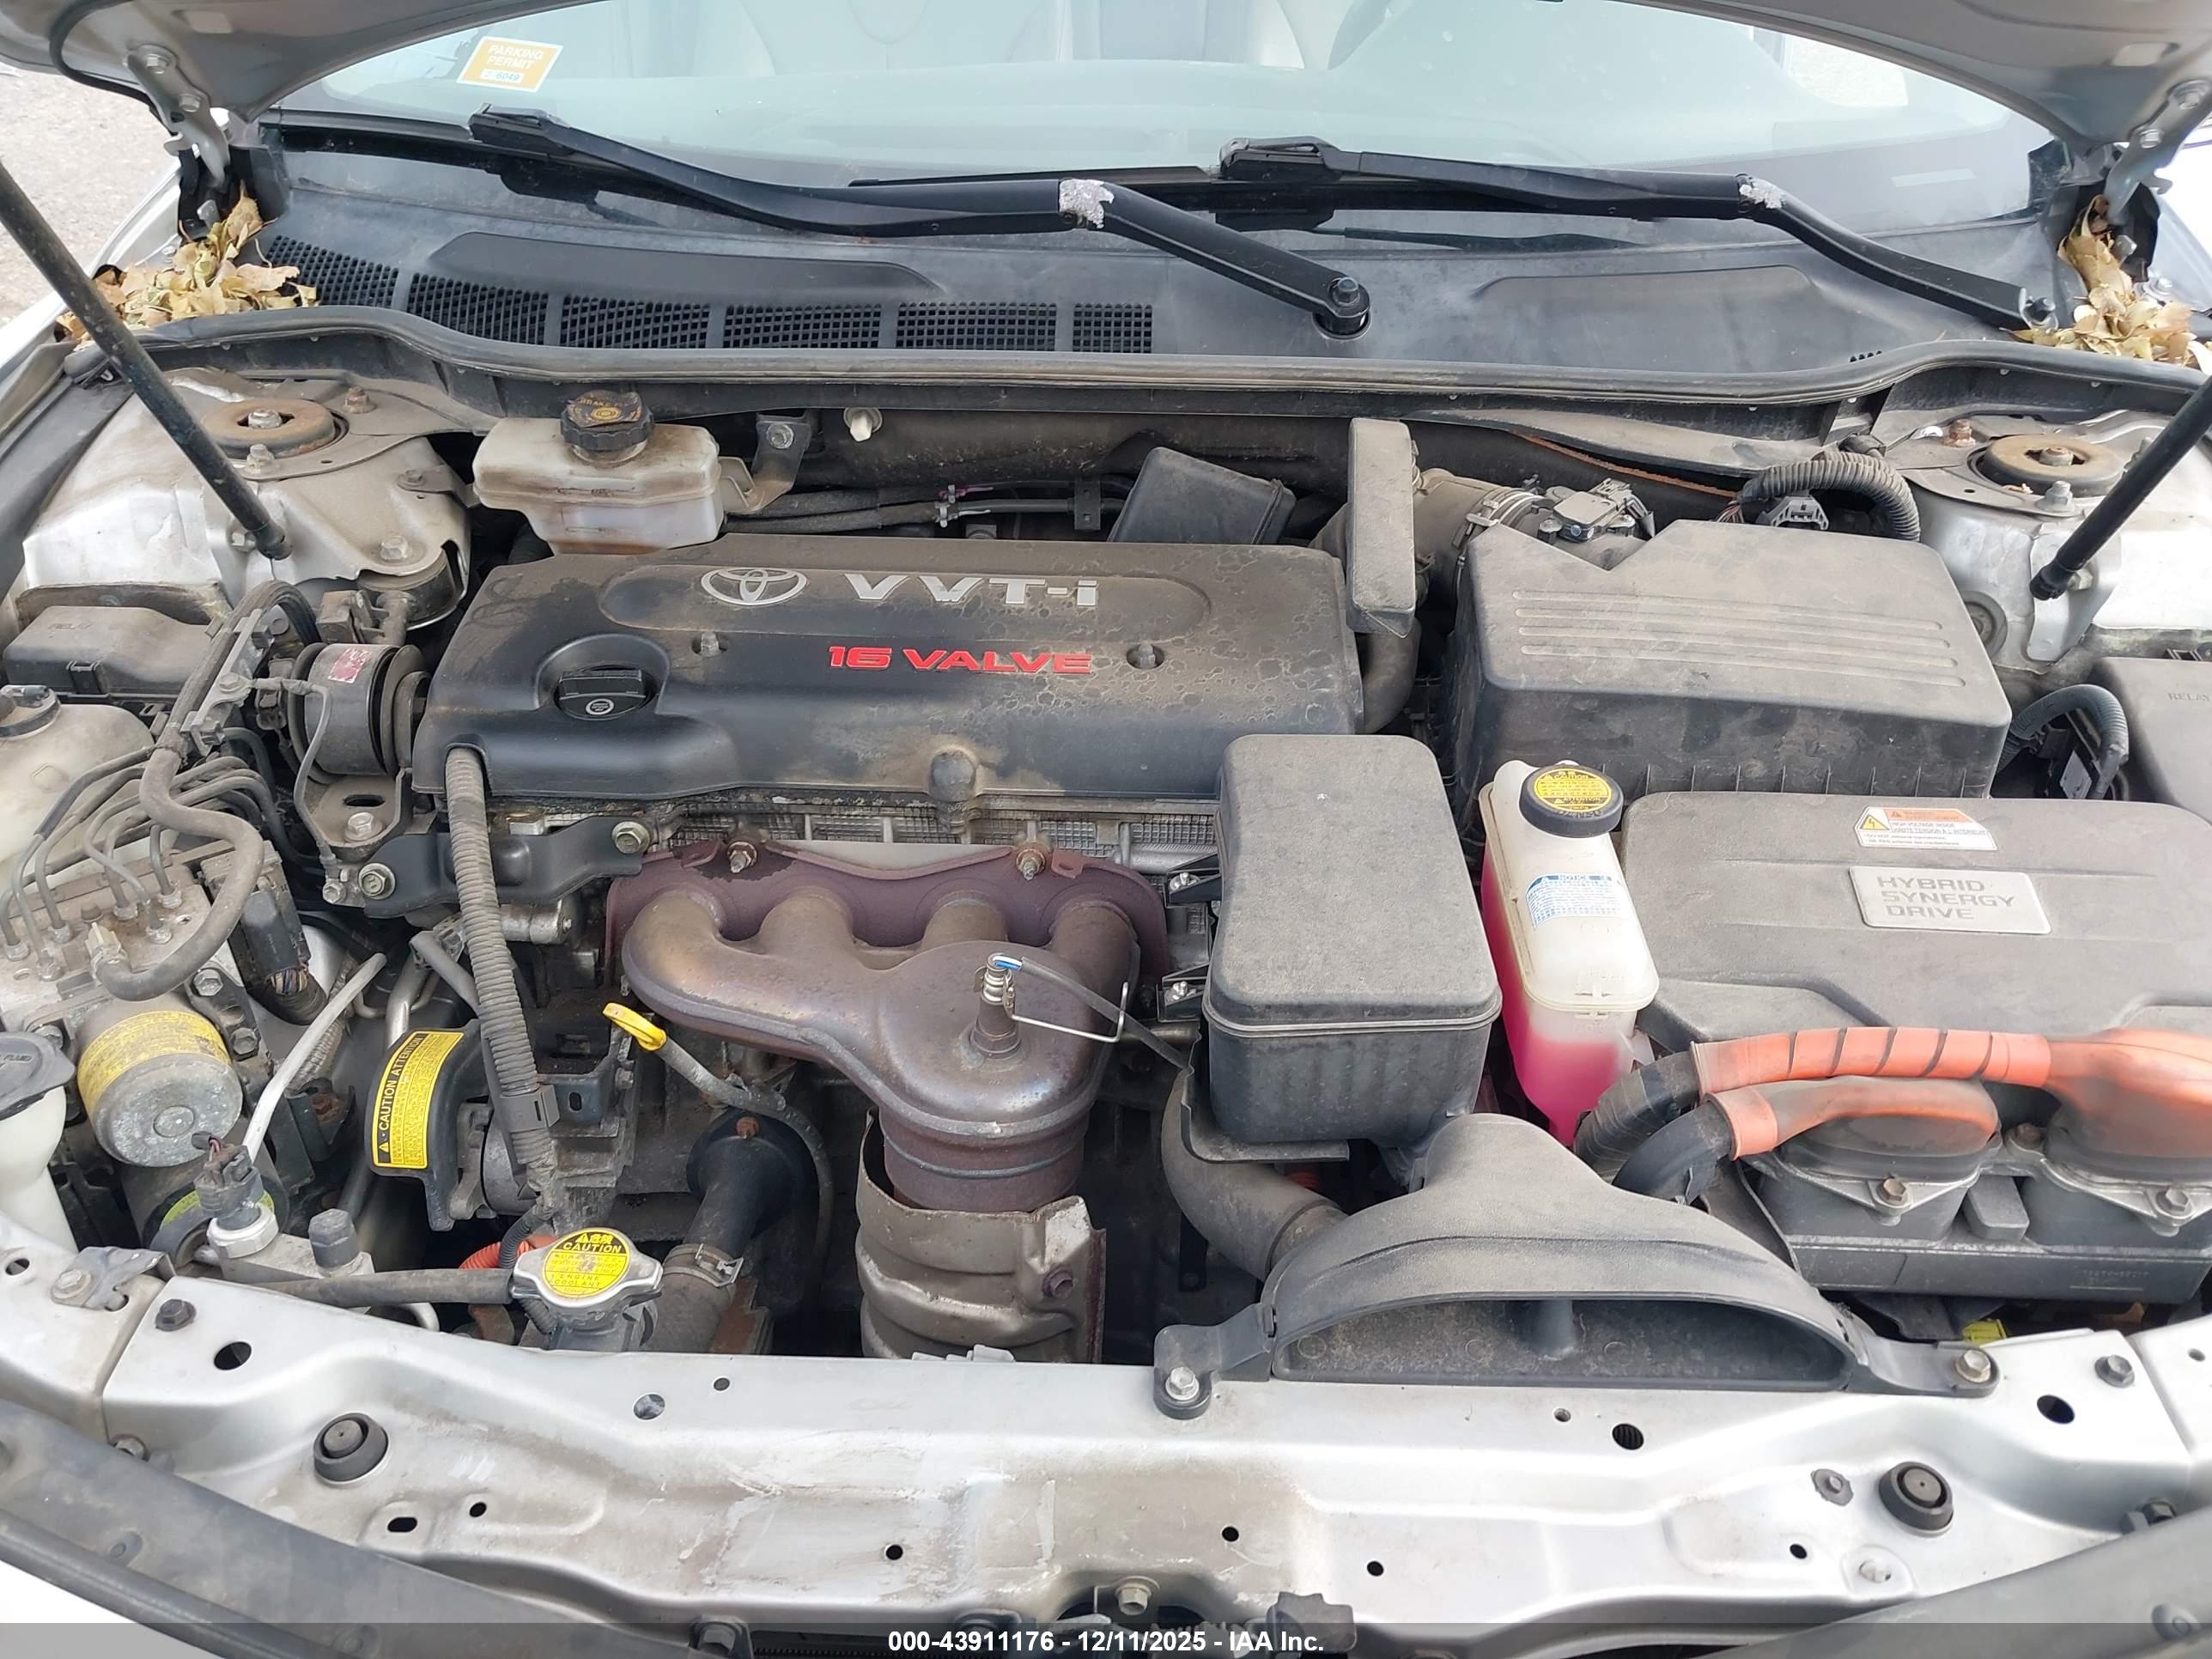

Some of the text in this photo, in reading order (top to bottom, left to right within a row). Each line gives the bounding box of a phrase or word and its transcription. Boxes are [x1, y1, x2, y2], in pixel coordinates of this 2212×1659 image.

[487, 45, 544, 60] PARKING
[486, 55, 536, 69] PERMIT
[843, 573, 1098, 605] VVT-i
[829, 646, 1092, 674] 16 VALVE
[1876, 877, 1984, 891] HYBRID
[1881, 891, 2015, 908] SYNERGY
[1886, 905, 1975, 920] DRIVE
[379, 1036, 423, 1131] CAUTION ATTENTION
[562, 1242, 622, 1253] CAUTION
